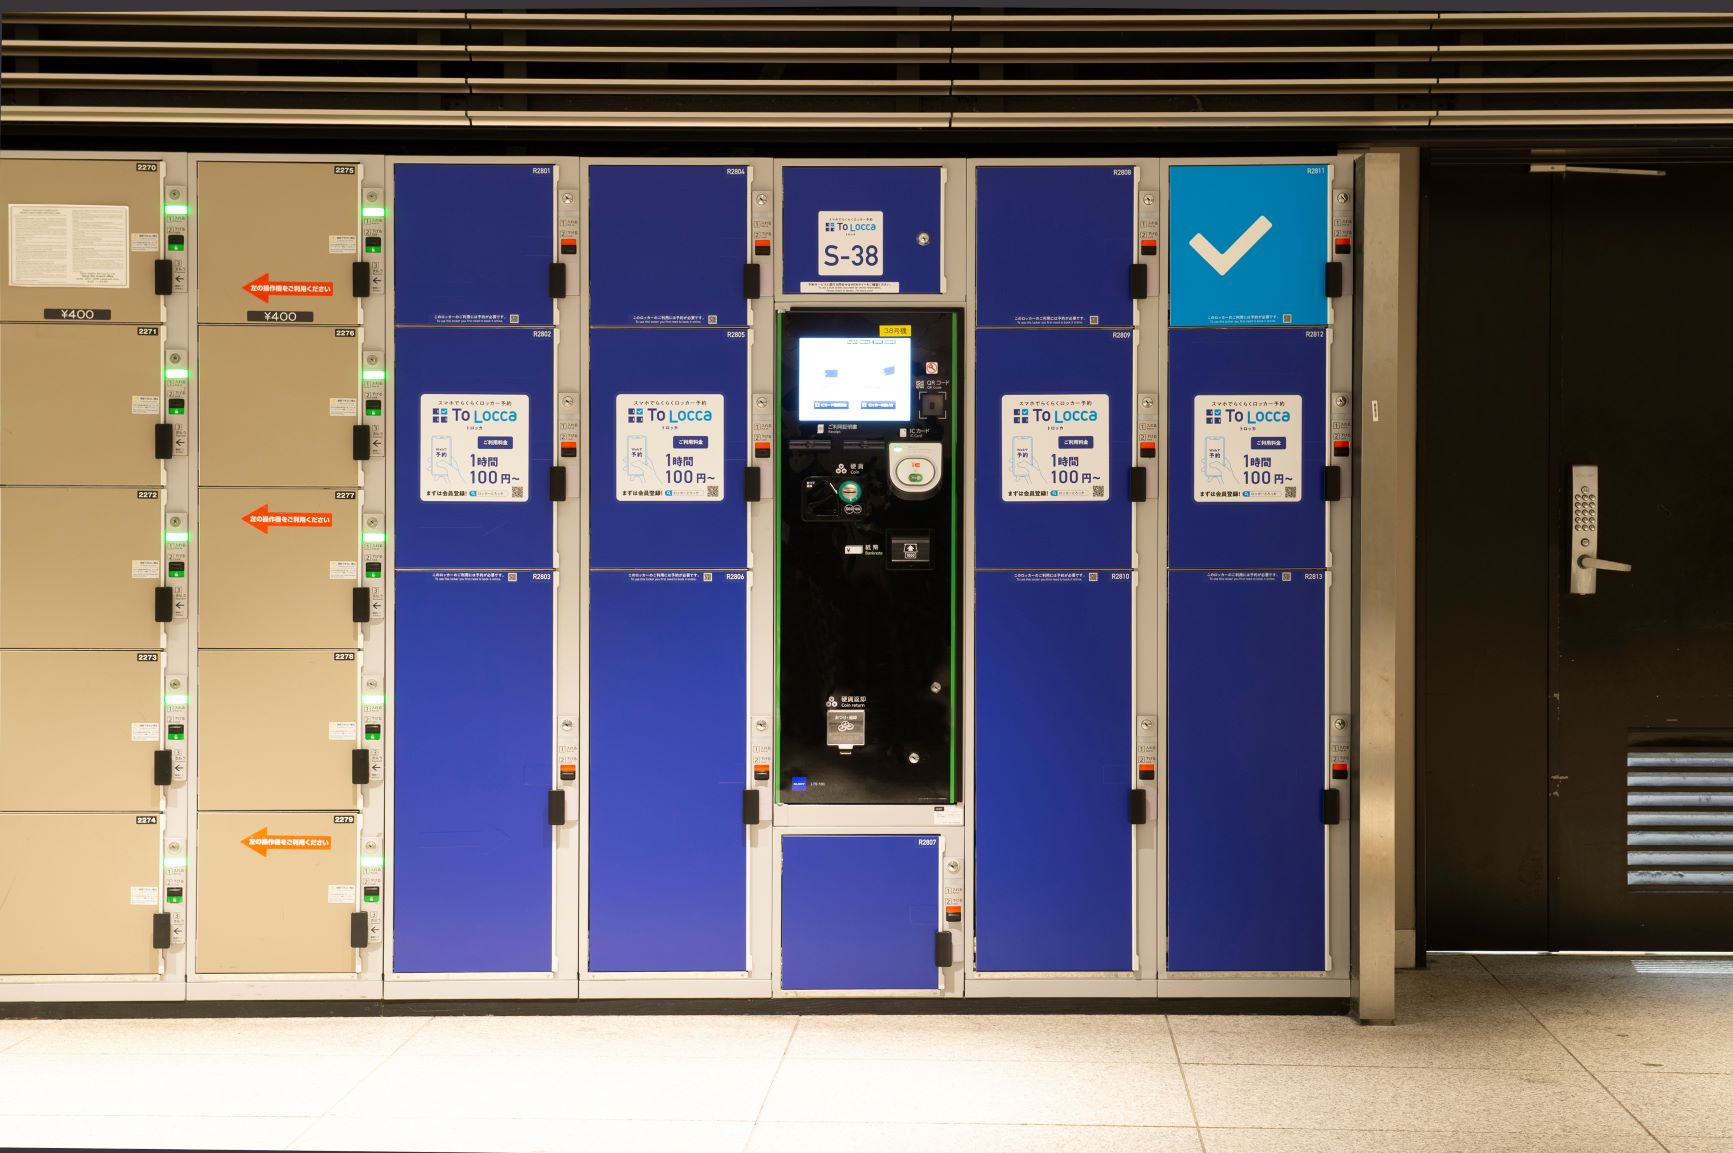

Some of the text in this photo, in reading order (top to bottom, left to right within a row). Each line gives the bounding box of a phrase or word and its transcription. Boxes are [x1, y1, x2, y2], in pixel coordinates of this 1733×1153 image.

[837, 222, 876, 232] To Locca
[824, 245, 878, 266] S-38
[61, 309, 94, 320] ¥400
[264, 312, 297, 321] ¥400
[452, 408, 517, 423] To Locca
[648, 408, 712, 423] To Locca
[1033, 409, 1098, 423] To Locca
[1225, 409, 1290, 424] To Locca
[470, 454, 498, 467] 1時間
[666, 454, 693, 467] 1時間
[1051, 454, 1079, 467] 1時間
[1244, 454, 1271, 467] 1時間
